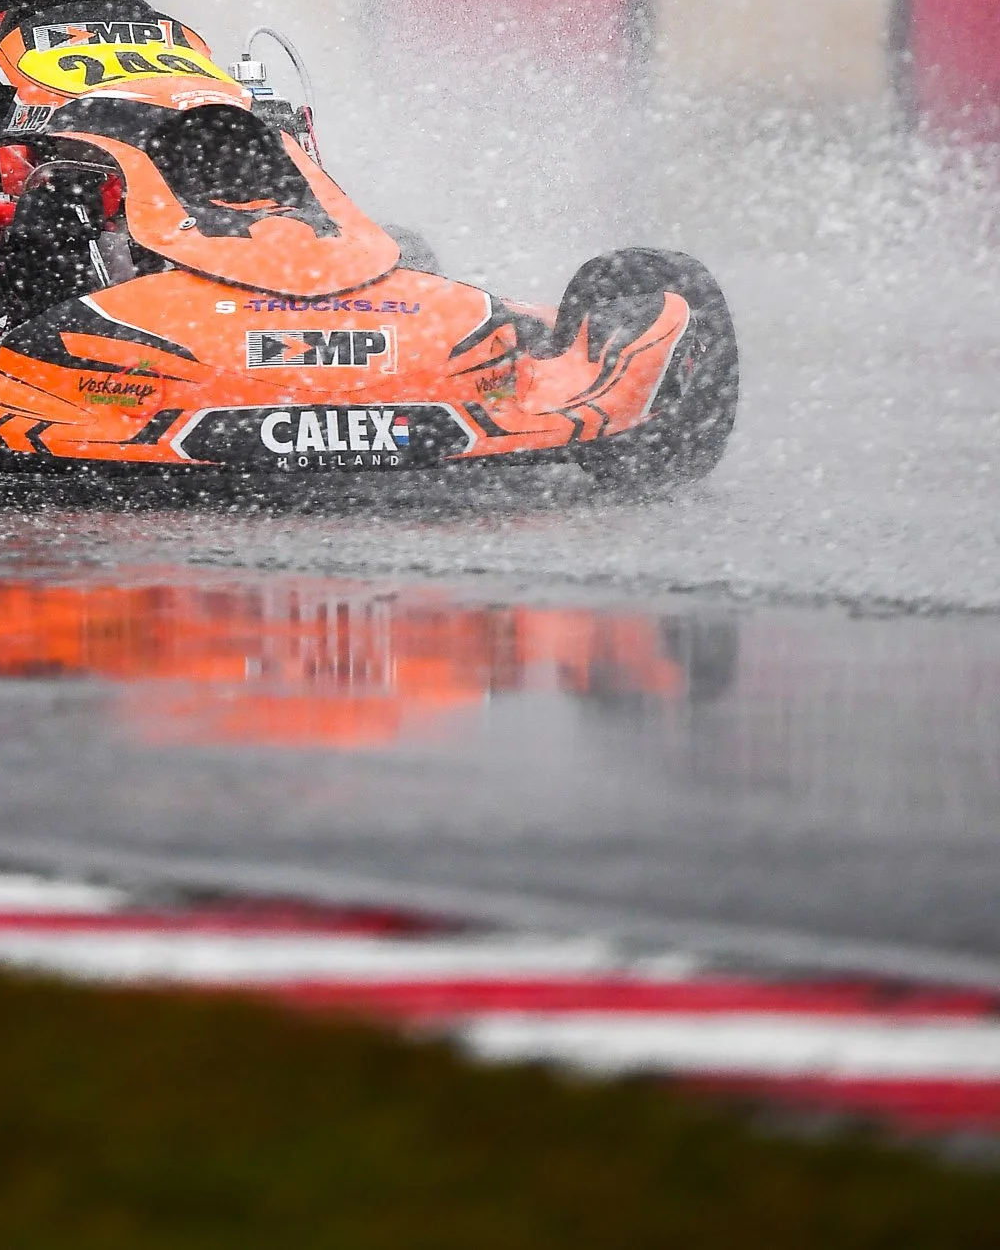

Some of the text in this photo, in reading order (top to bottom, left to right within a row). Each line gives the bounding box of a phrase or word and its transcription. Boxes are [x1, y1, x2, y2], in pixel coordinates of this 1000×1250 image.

[78, 374, 157, 406] Voskamp
[260, 410, 399, 454] CALEX
[277, 454, 400, 469] HOLLAND
